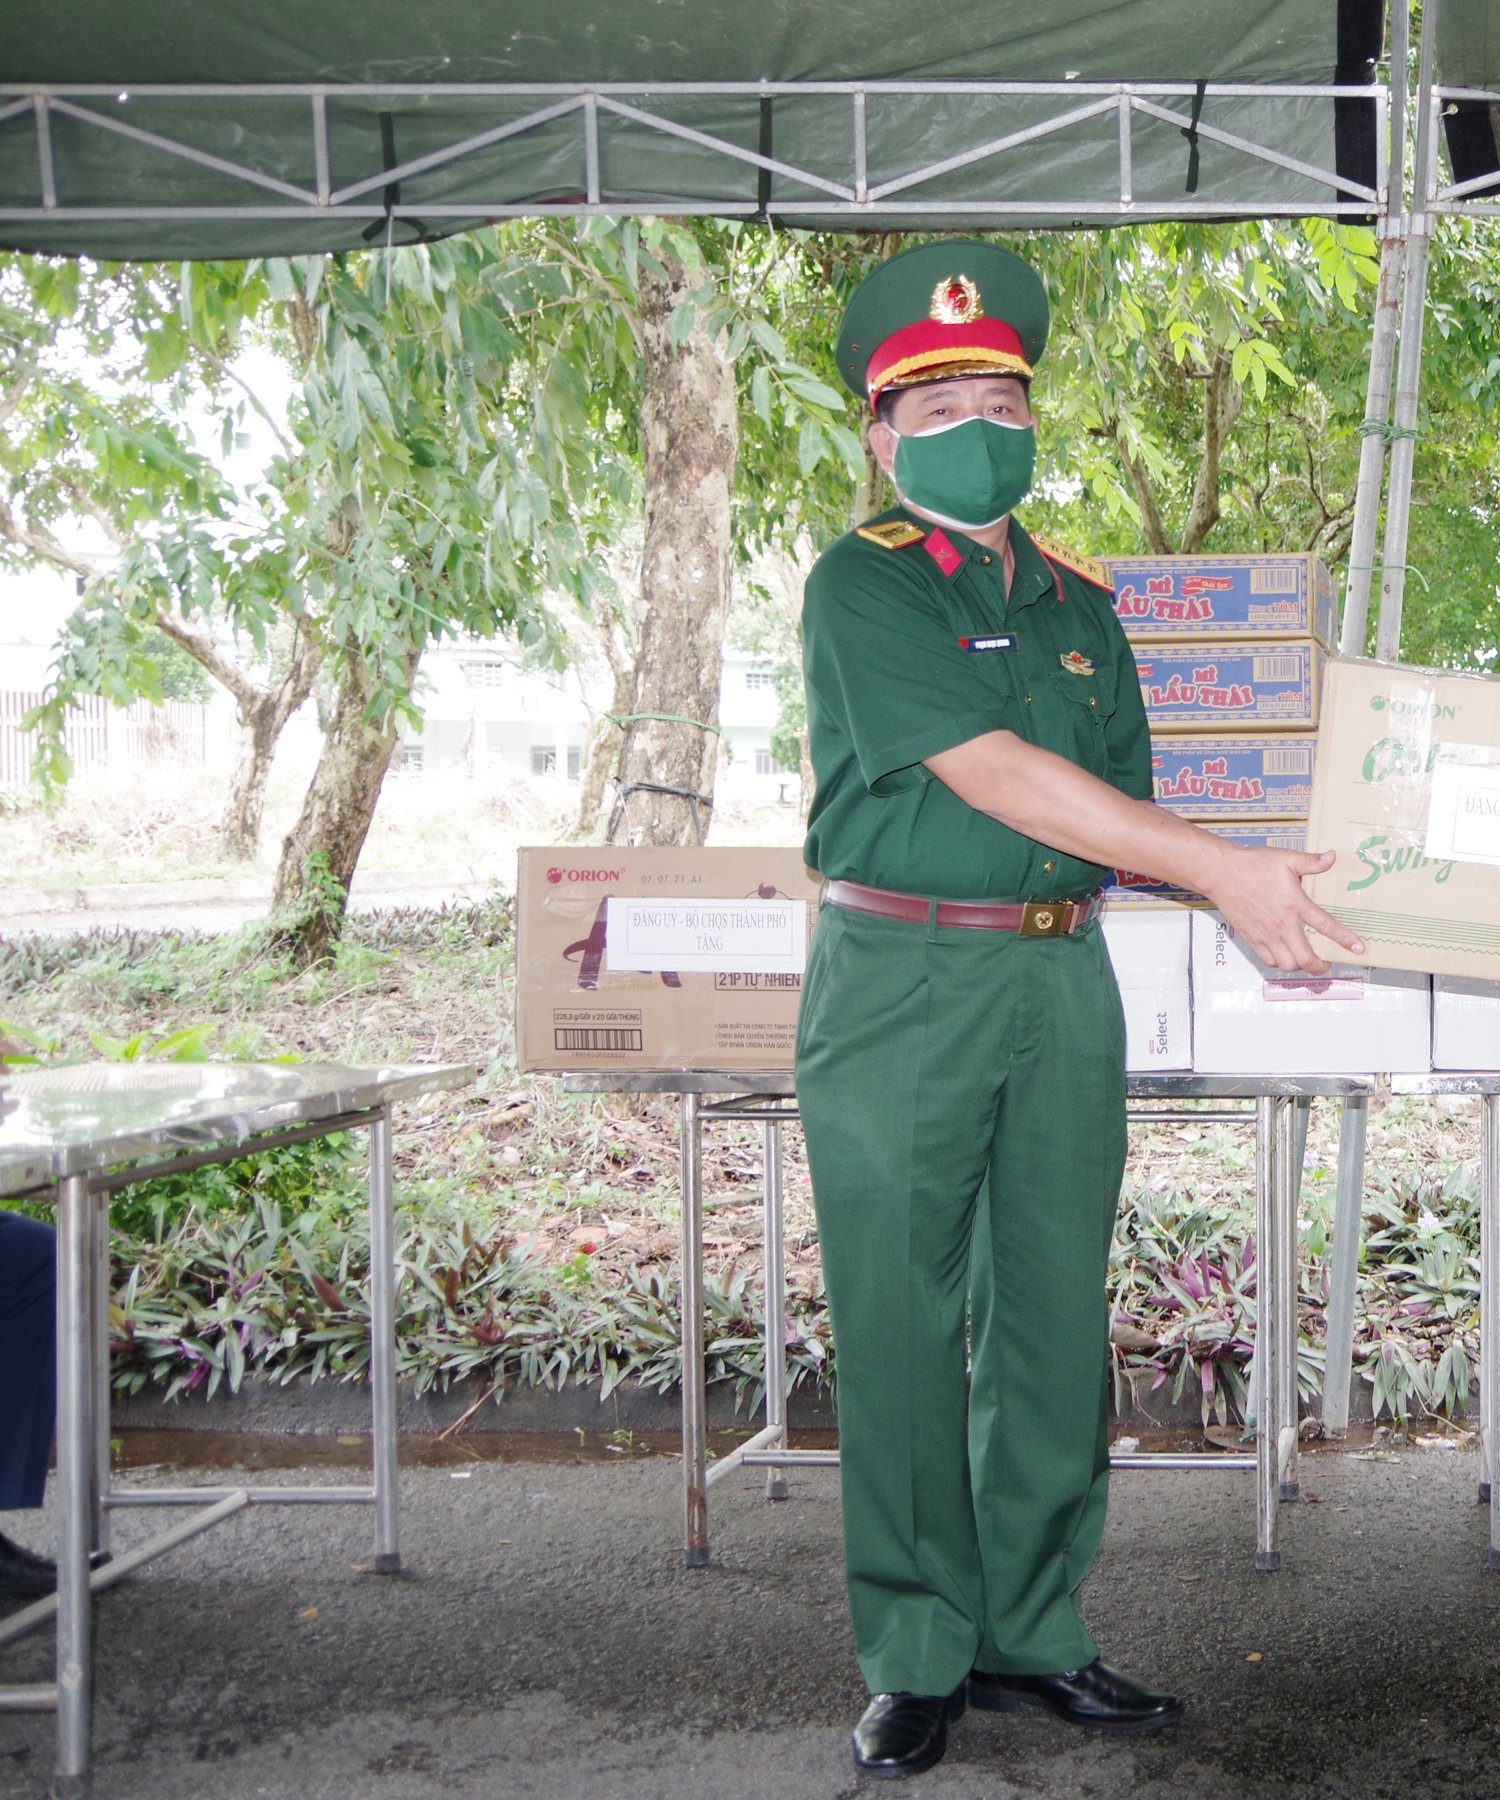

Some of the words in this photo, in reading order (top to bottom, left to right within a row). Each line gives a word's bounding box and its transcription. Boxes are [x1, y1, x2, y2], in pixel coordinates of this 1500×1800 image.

[1114, 587, 1151, 616] ẨU
[568, 870, 619, 882] ORION
[702, 913, 729, 930] CHQS
[696, 932, 724, 953] TẶNG
[1216, 922, 1227, 966] Select
[1156, 1011, 1168, 1056] Select
